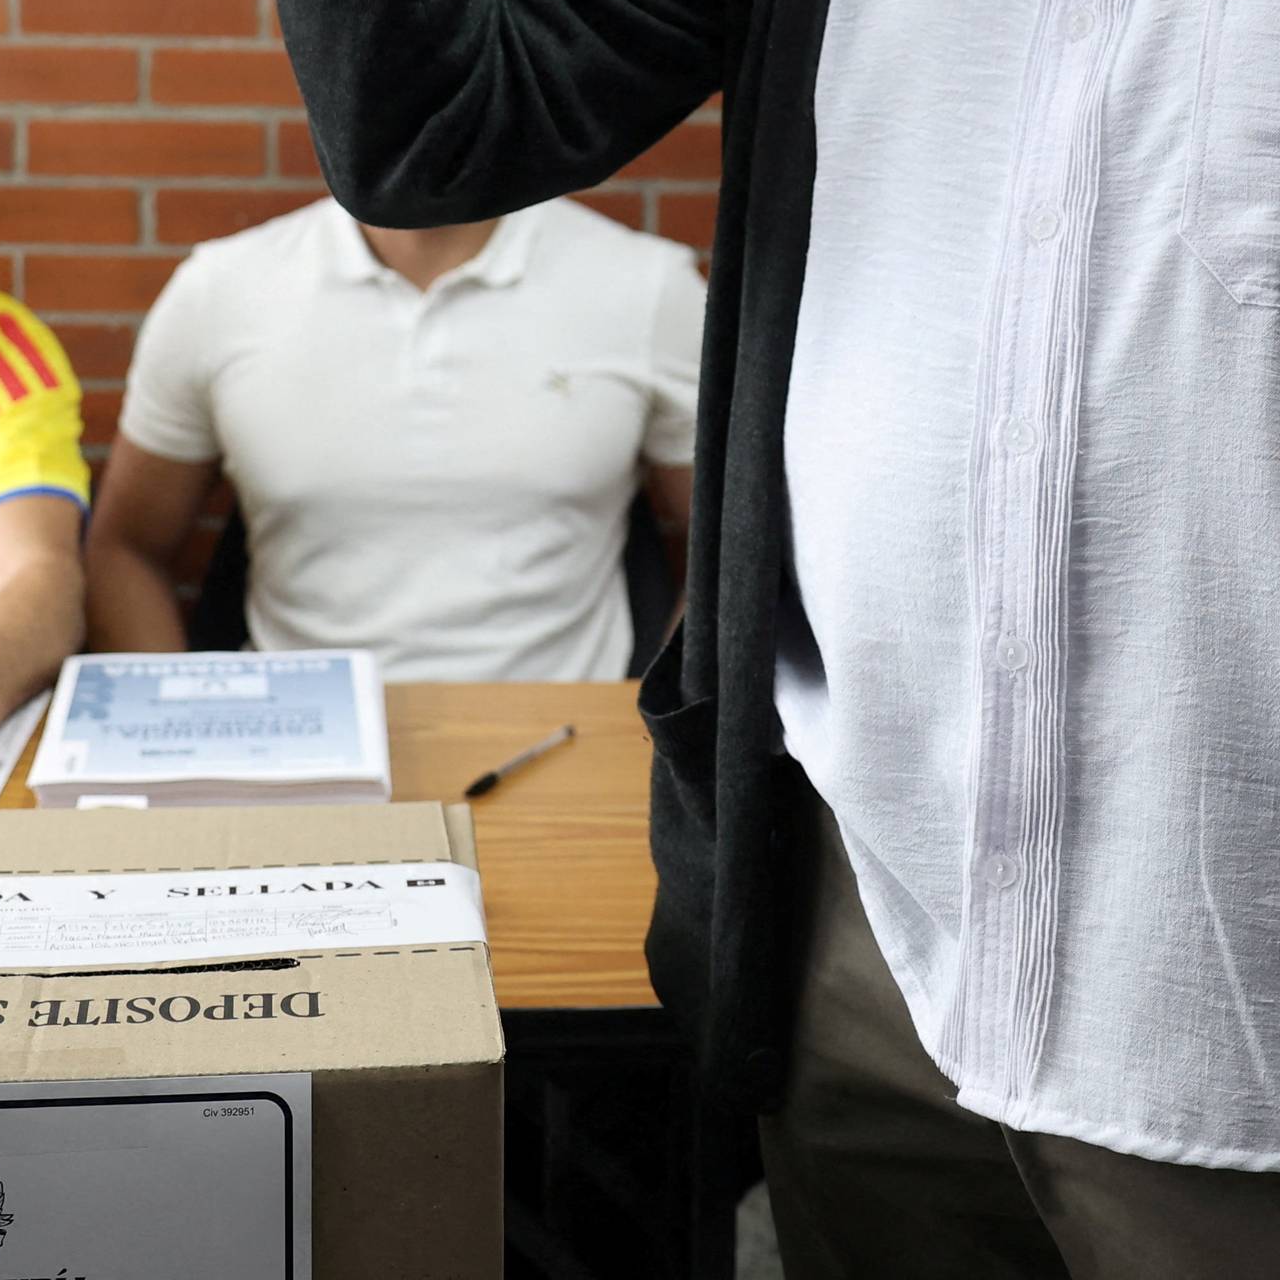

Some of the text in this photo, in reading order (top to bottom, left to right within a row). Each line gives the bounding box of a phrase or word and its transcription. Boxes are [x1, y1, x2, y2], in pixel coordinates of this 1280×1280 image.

[87, 888, 116, 900] Y
[166, 879, 385, 899] SELLADA
[27, 991, 326, 1028] DEPOSITE
[203, 1107, 255, 1118] Civ 392951
